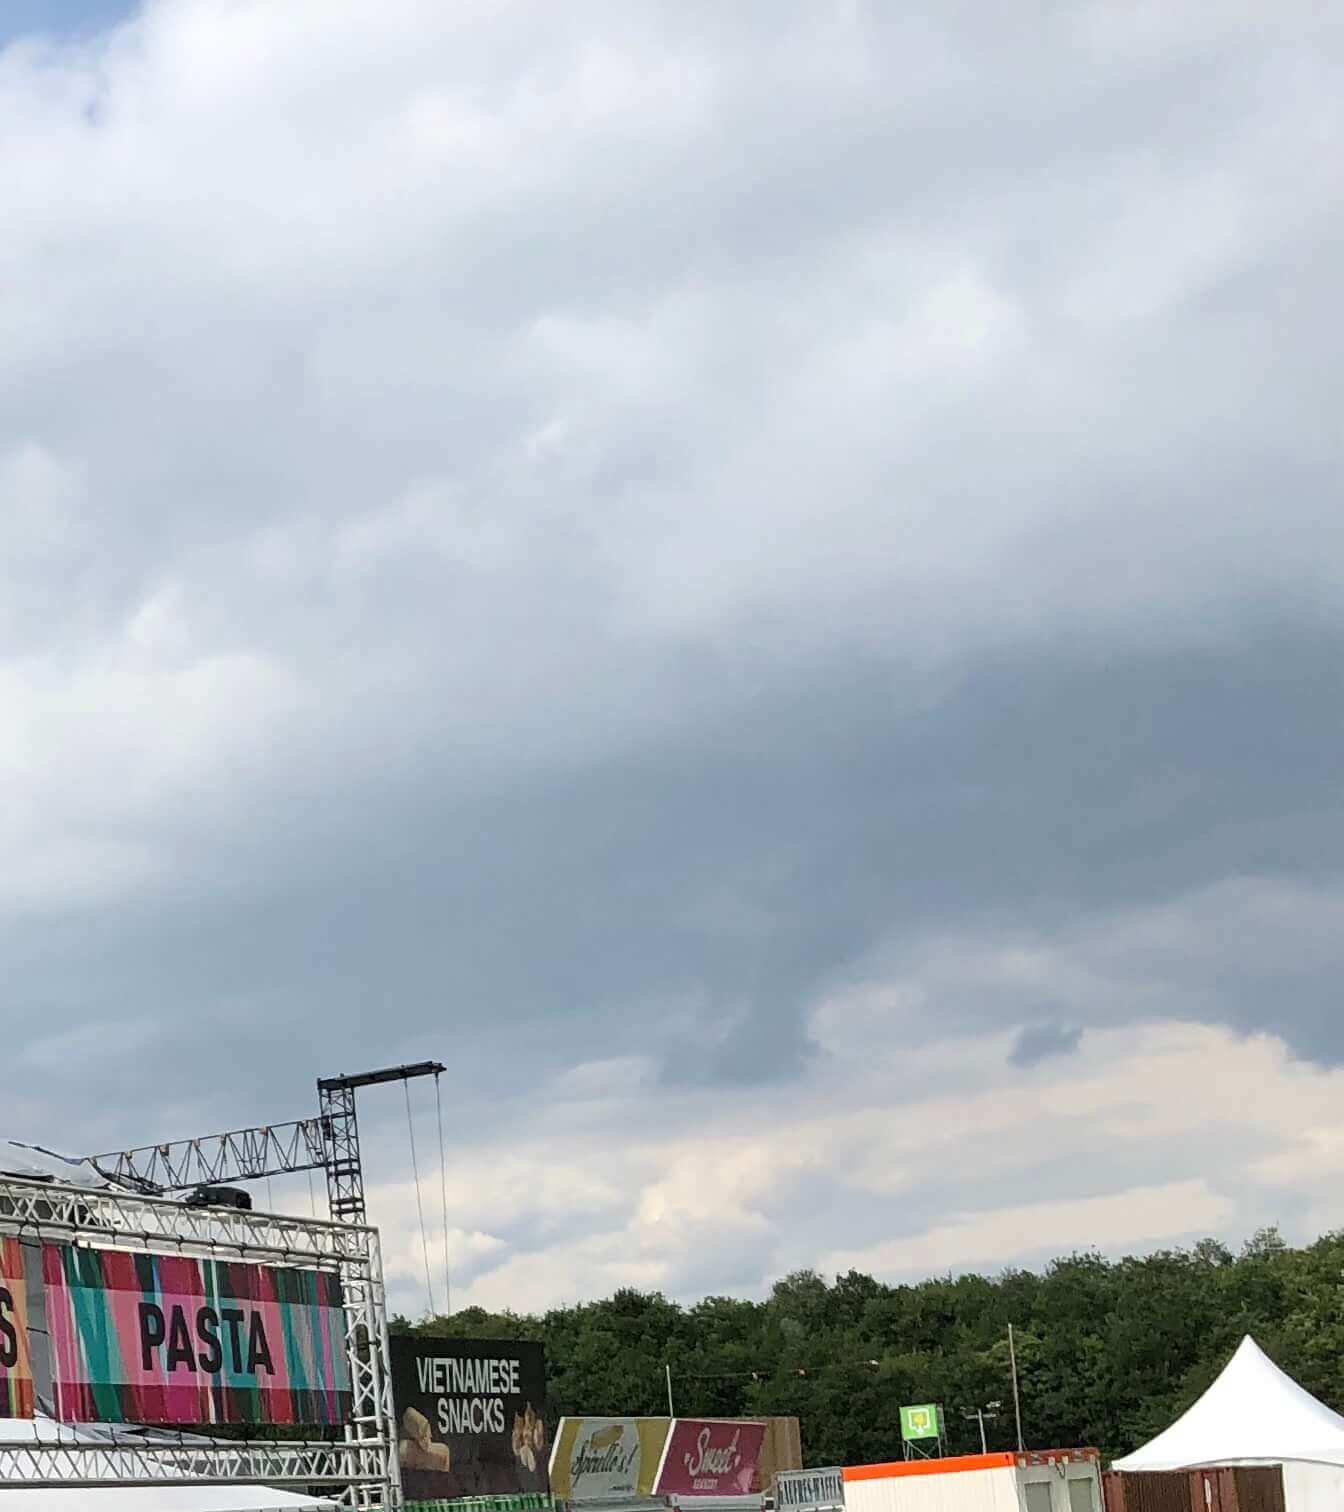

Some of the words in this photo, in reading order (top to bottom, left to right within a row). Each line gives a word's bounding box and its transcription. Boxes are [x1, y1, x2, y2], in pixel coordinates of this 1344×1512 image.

[137, 1301, 275, 1377] PASTA
[416, 1357, 520, 1394] VIETNAMESE
[437, 1398, 505, 1434] SNACKS
[688, 1427, 741, 1477] Sweet
